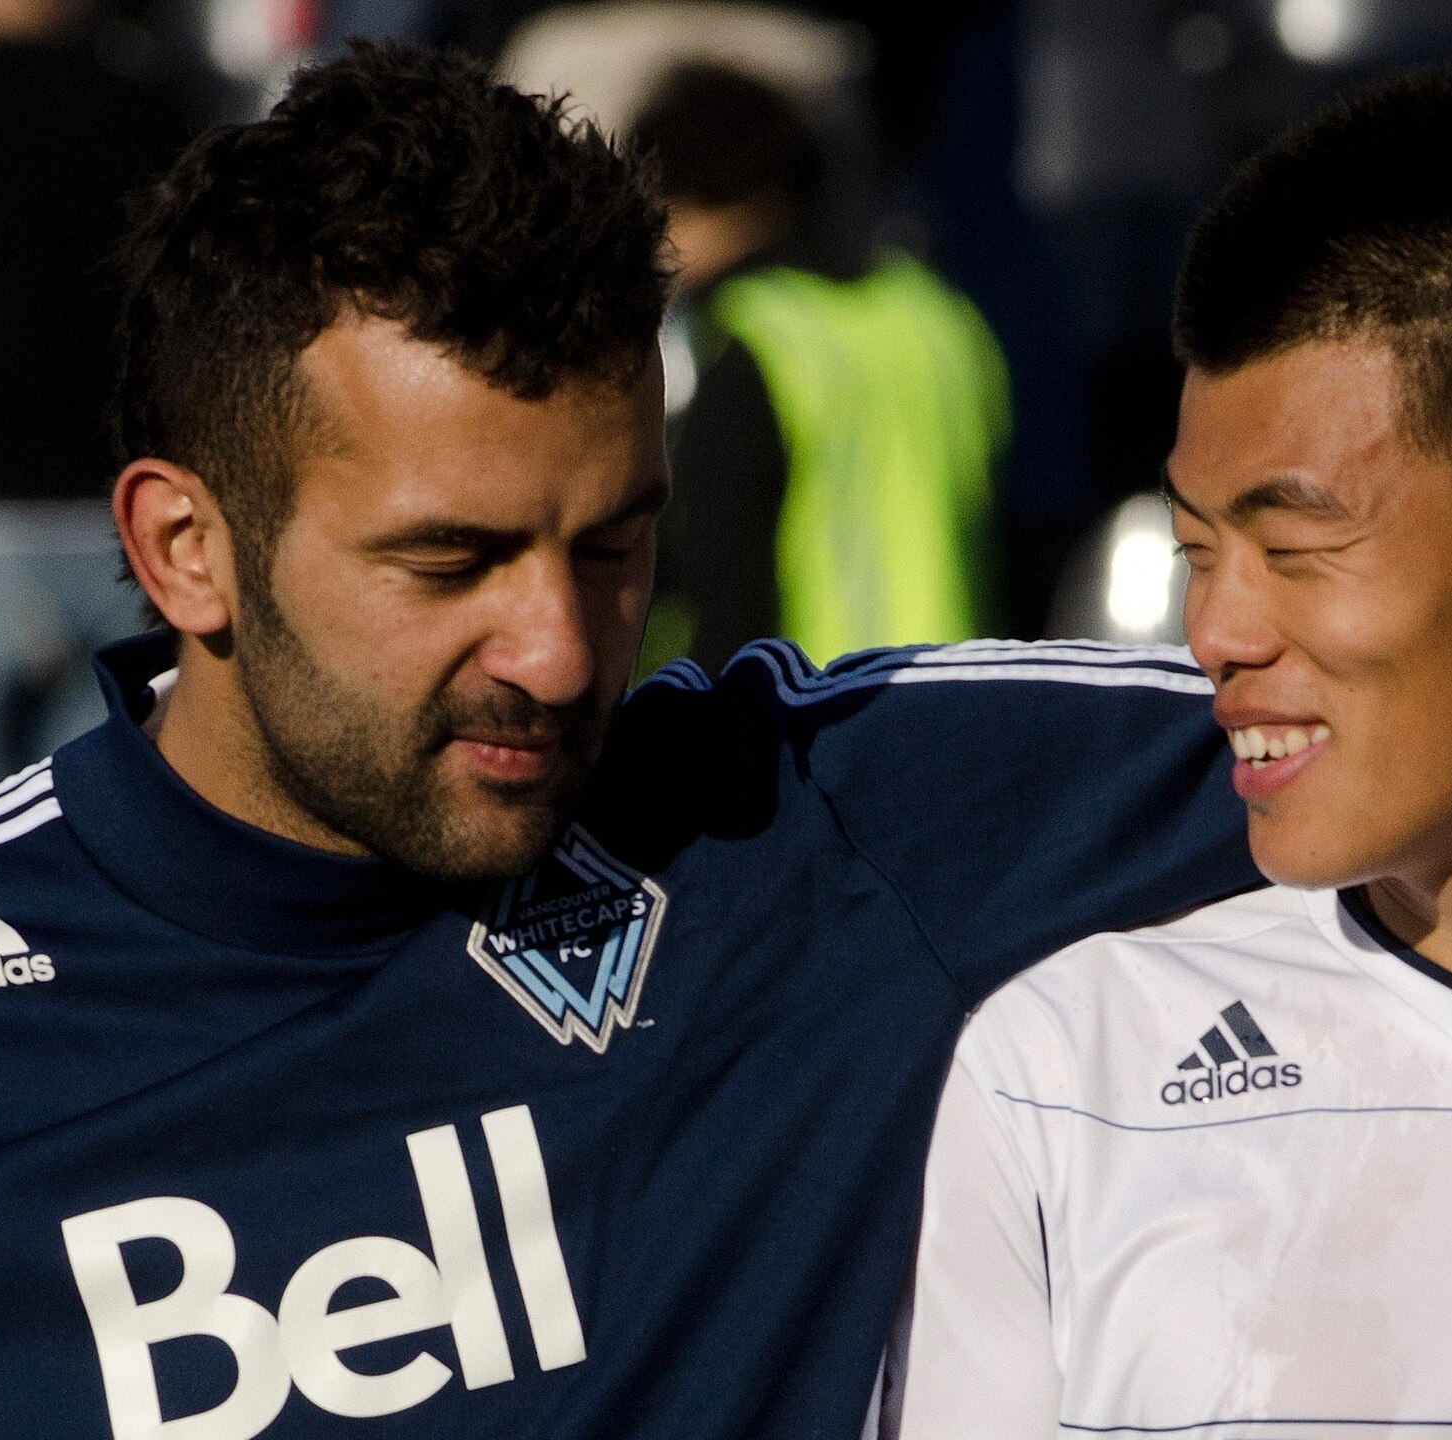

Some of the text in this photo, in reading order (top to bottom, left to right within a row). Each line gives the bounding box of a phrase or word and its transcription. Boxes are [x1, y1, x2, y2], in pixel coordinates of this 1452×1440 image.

[488, 892, 647, 954] WHITECAPS
[558, 935, 593, 963] FC
[1161, 1060, 1302, 1105] adidas
